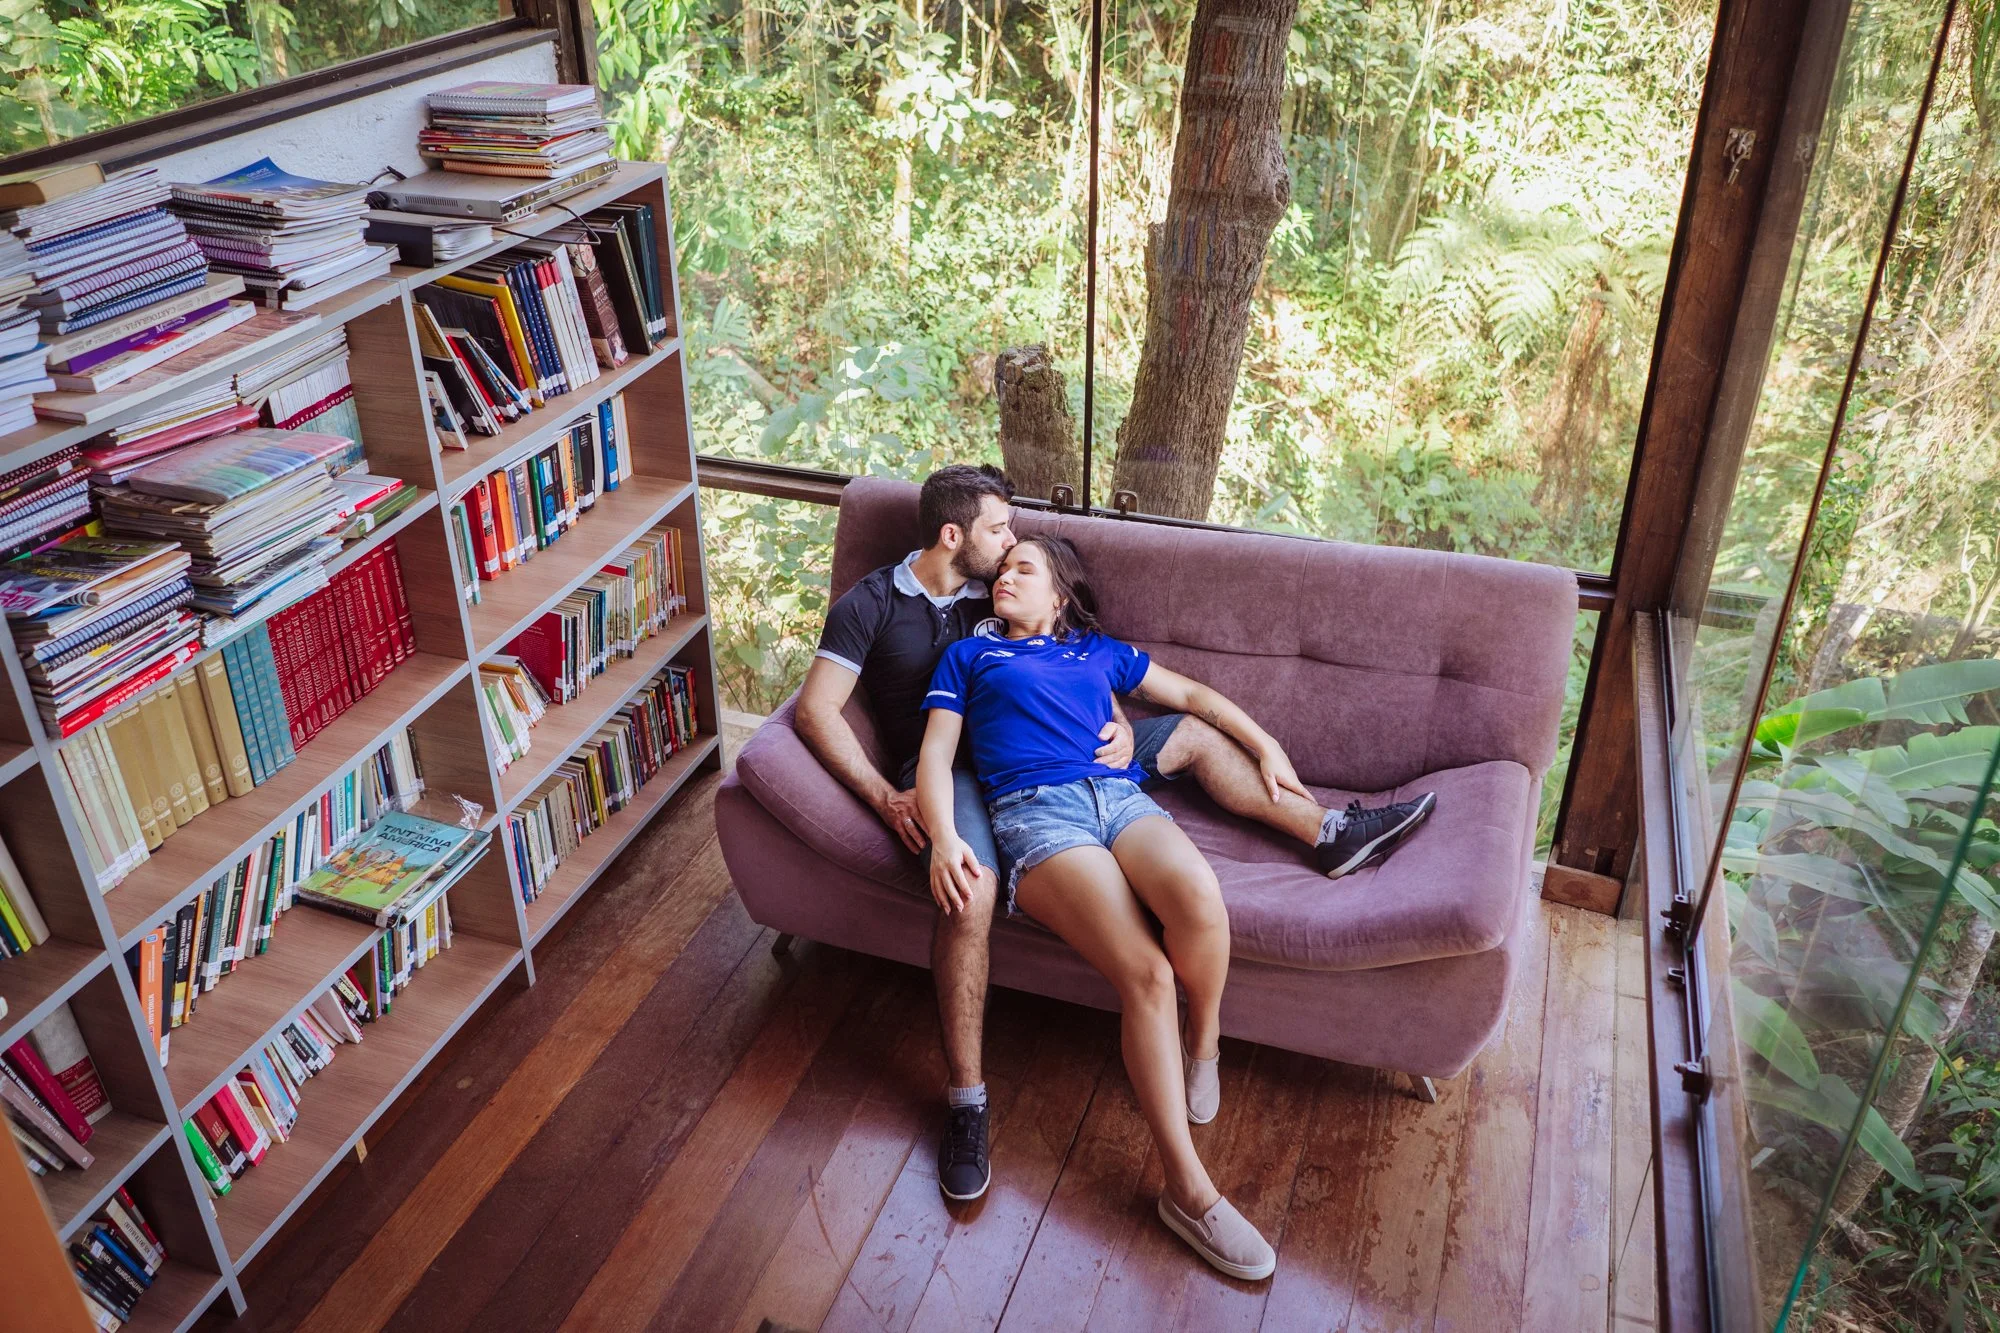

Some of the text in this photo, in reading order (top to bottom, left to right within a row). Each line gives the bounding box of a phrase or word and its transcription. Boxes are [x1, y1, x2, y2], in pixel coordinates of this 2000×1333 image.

[317, 611, 331, 647] GUERRA
[325, 648, 339, 688] MUNDIAL
[326, 605, 339, 641] GUERRA
[333, 642, 347, 682] MUNDIAL
[334, 599, 348, 635] GUERRA
[342, 636, 356, 675] MUNDIAL
[342, 593, 358, 629] GUERRA
[349, 629, 367, 668] MUNDIAL
[285, 634, 300, 671] GUERRA
[294, 672, 309, 713] MUNDIAL
[293, 628, 308, 664] GUERRA
[301, 666, 316, 706] MUNDIAL
[301, 621, 316, 658] GUERRA
[310, 660, 324, 700] MUNDIAL
[309, 617, 323, 653] GUERRA
[317, 654, 331, 694] MUNDIAL
[429, 836, 452, 849] NA
